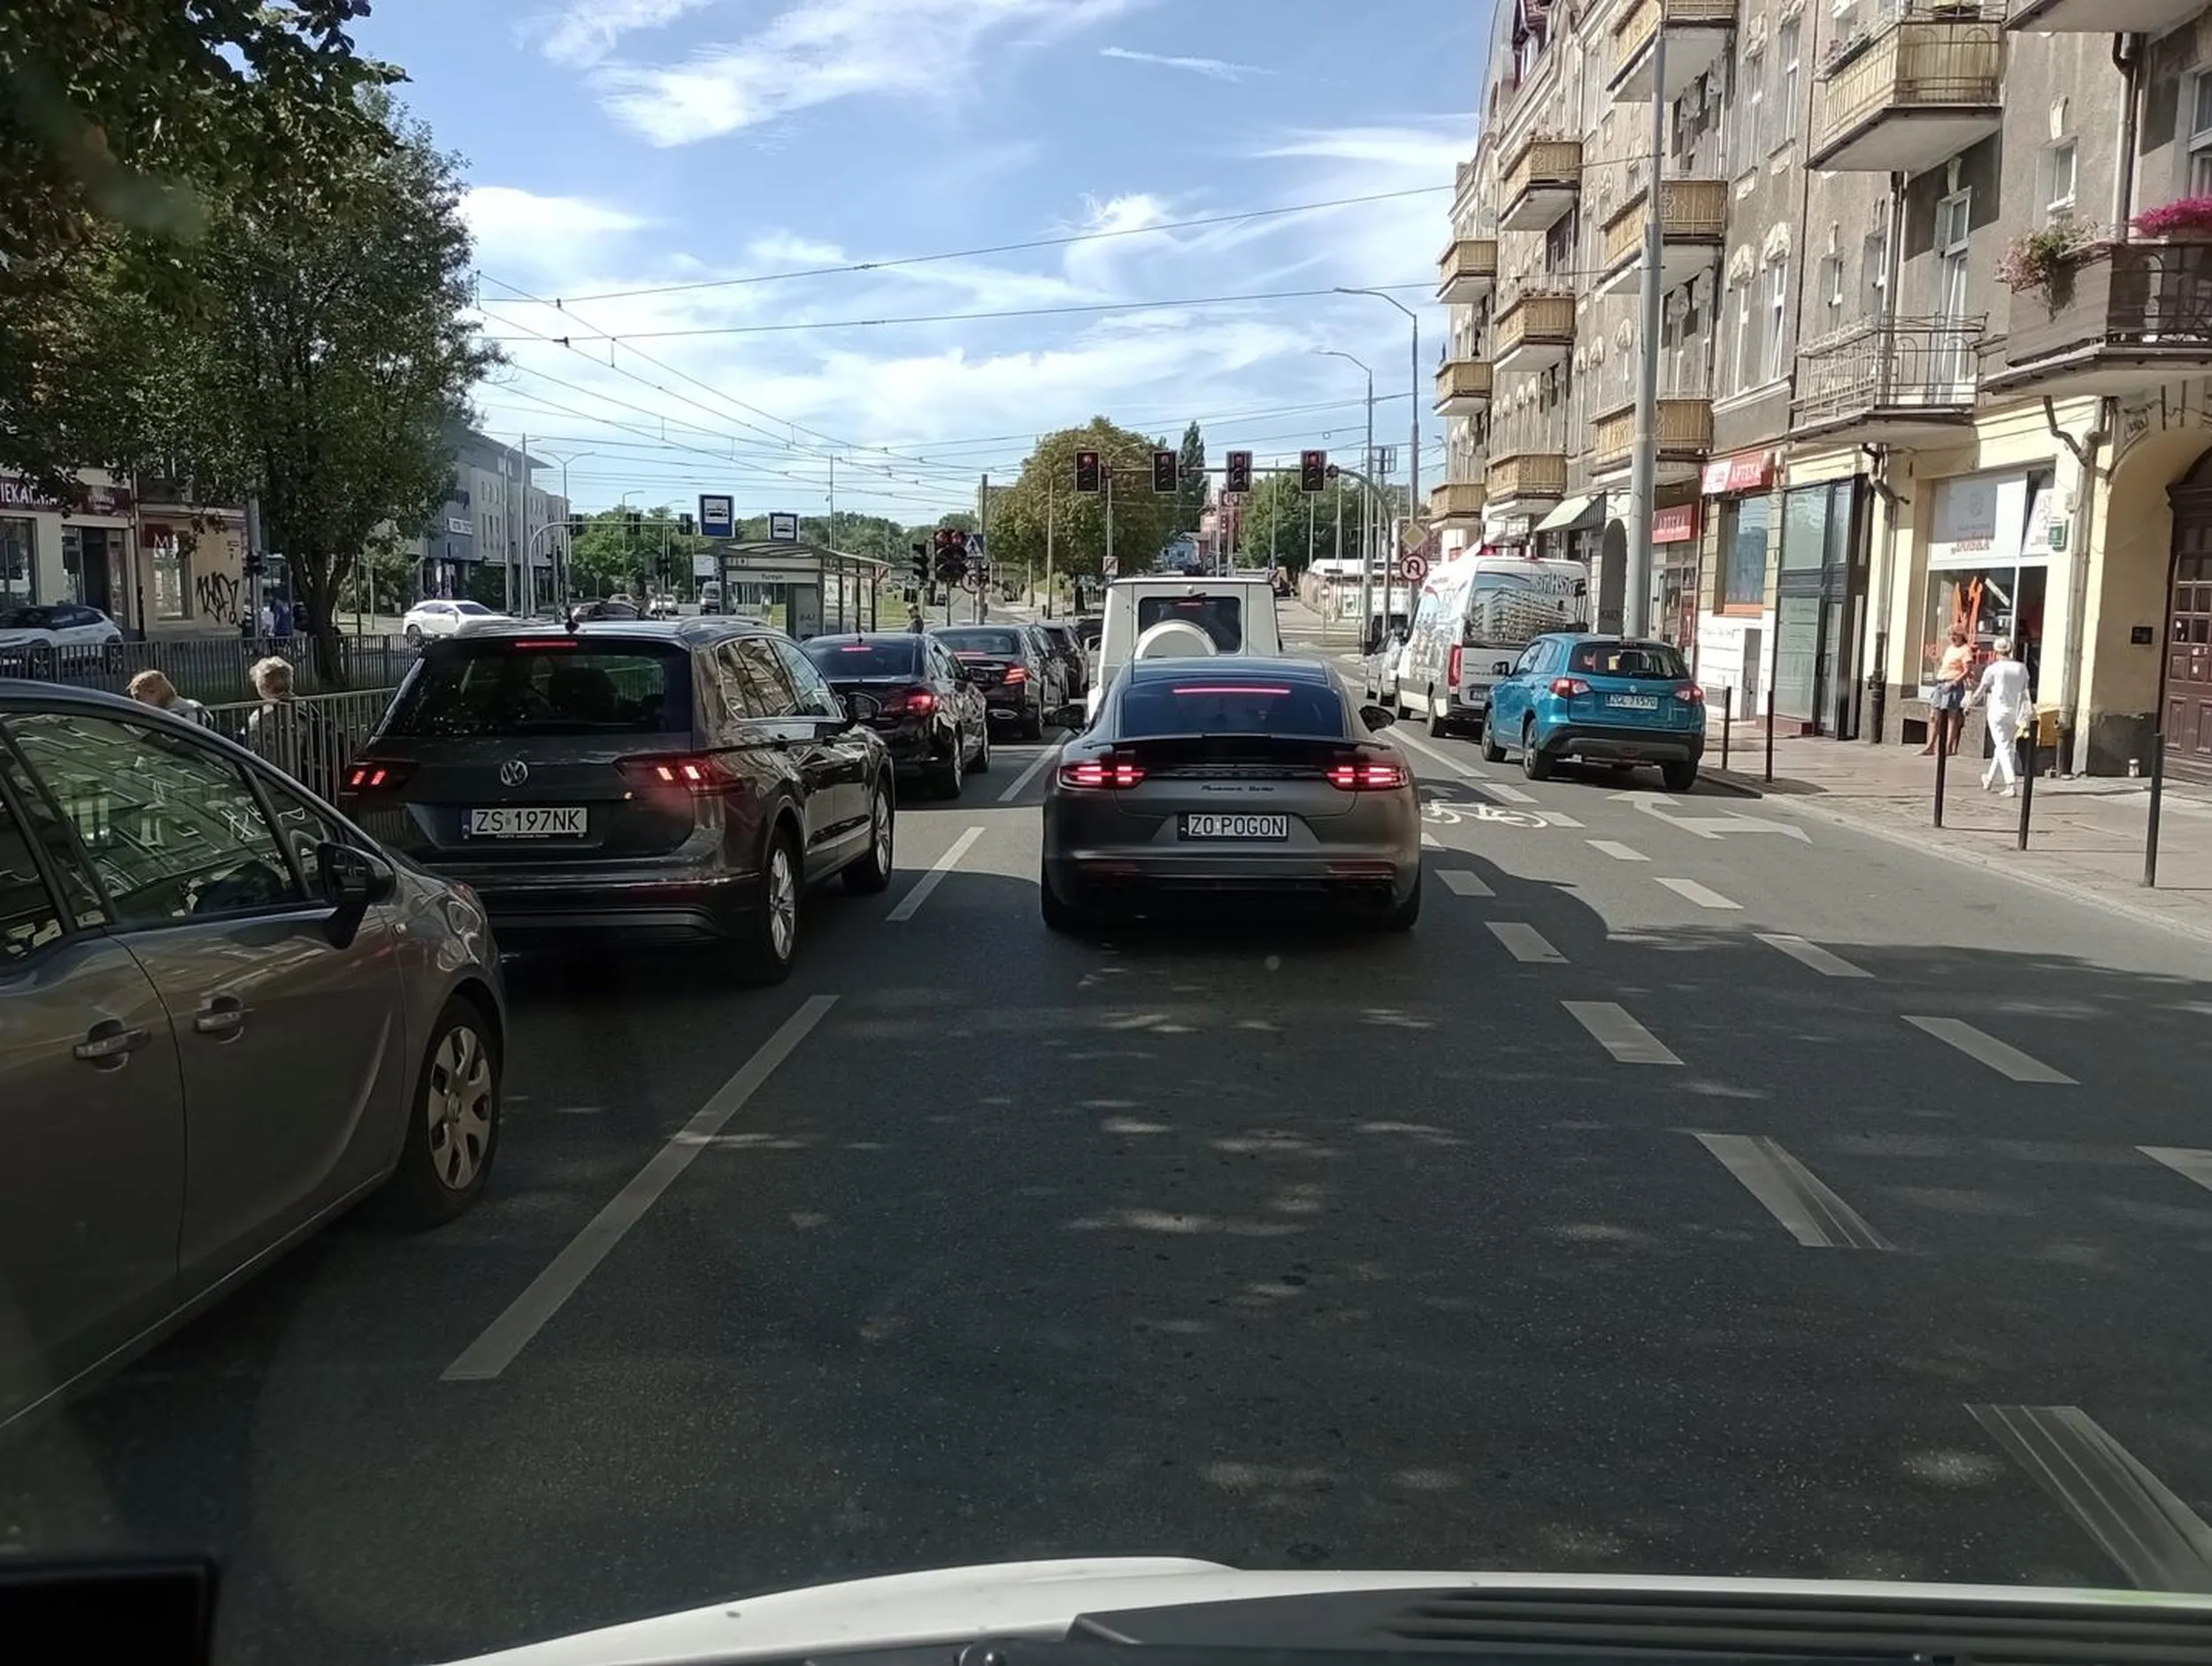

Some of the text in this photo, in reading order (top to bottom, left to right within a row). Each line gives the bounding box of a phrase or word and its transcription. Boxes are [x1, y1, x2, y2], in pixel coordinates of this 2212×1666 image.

[476, 809, 580, 832] ZS 197NK
[1221, 816, 1284, 835] POGON
